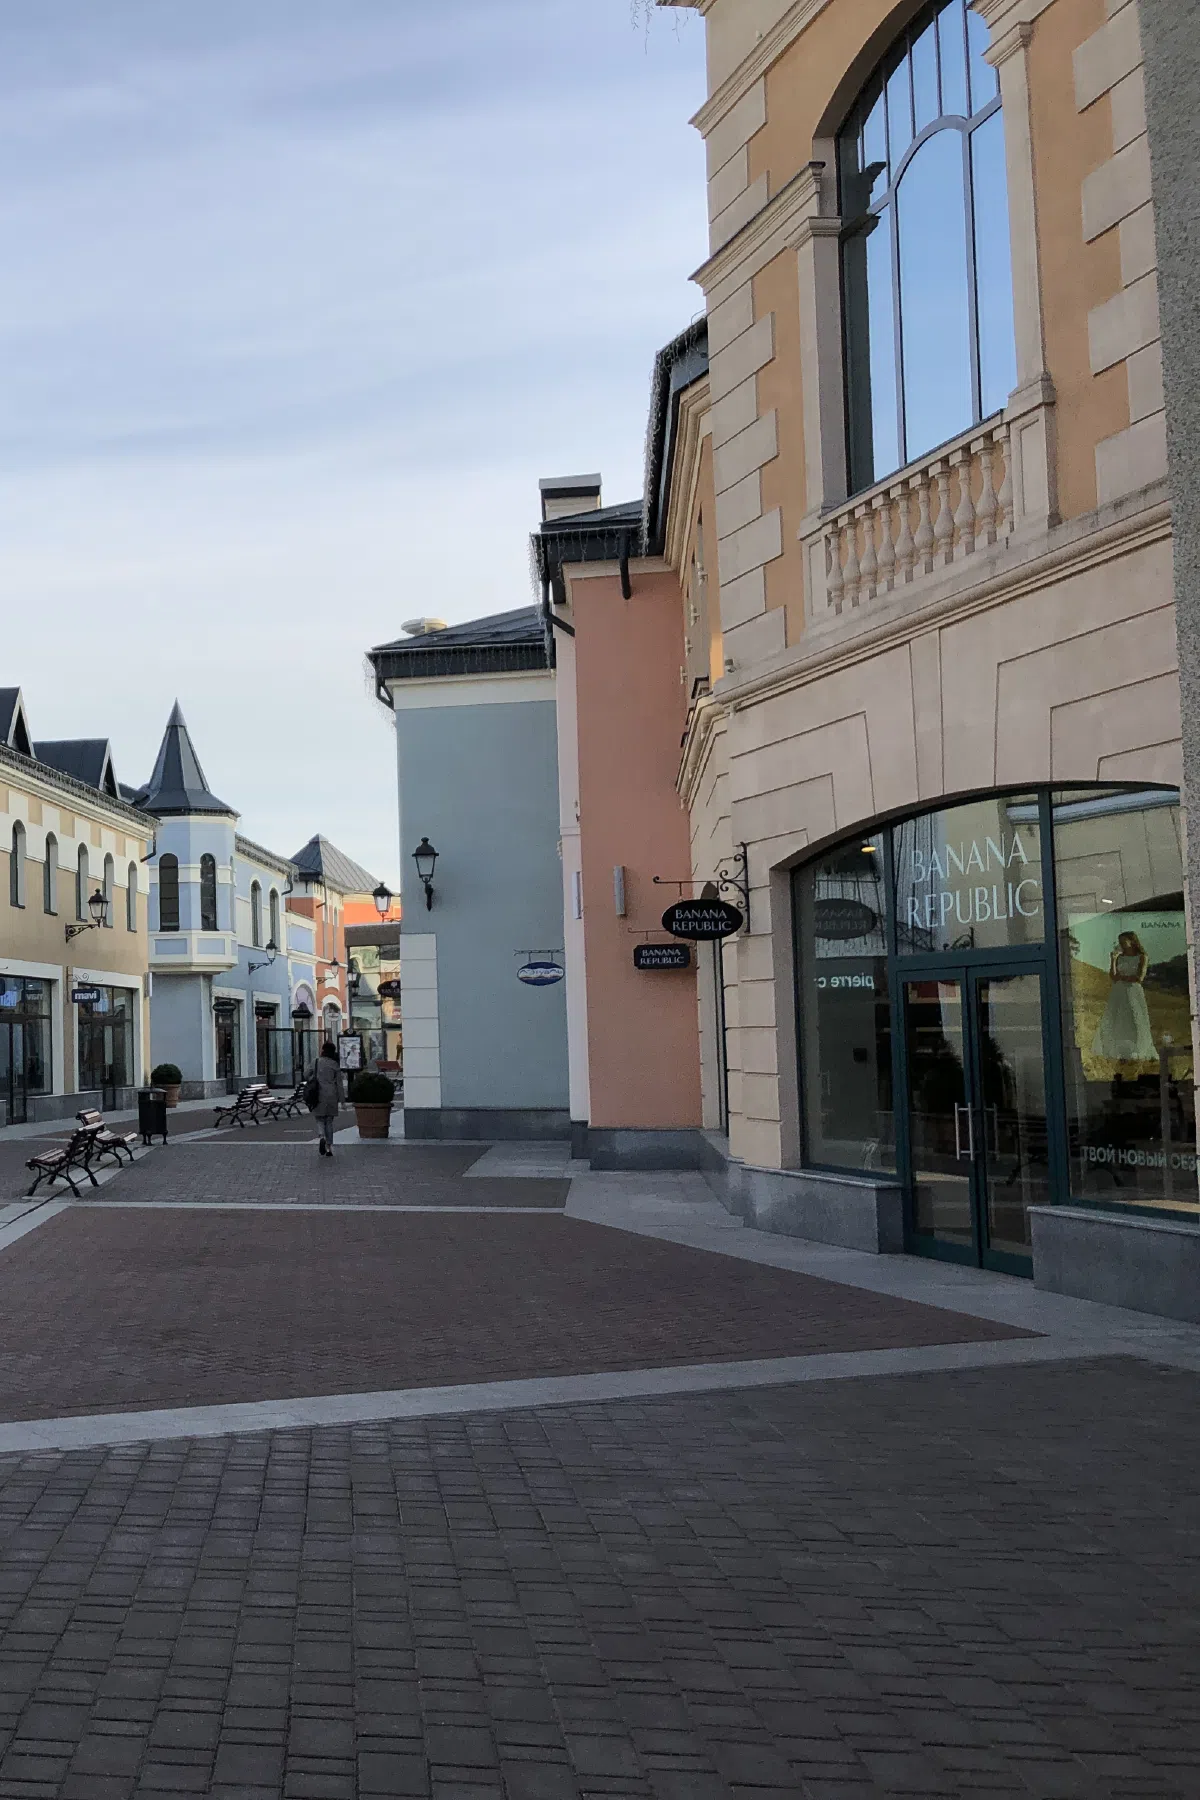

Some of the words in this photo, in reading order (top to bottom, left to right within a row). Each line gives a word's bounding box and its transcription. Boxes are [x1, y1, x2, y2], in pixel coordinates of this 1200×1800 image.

[910, 831, 1030, 883] BANANA
[906, 878, 1040, 929] REPUBLIC
[675, 908, 728, 919] BANANA
[672, 920, 732, 931] REPUBLIC
[1141, 921, 1181, 929] BANANA
[642, 948, 681, 957] BANANA
[640, 956, 685, 965] REPUBLIC
[74, 990, 97, 1000] mavi
[1081, 1144, 1115, 1163] ТВОЙ
[1118, 1148, 1167, 1167] НОВЫЙ
